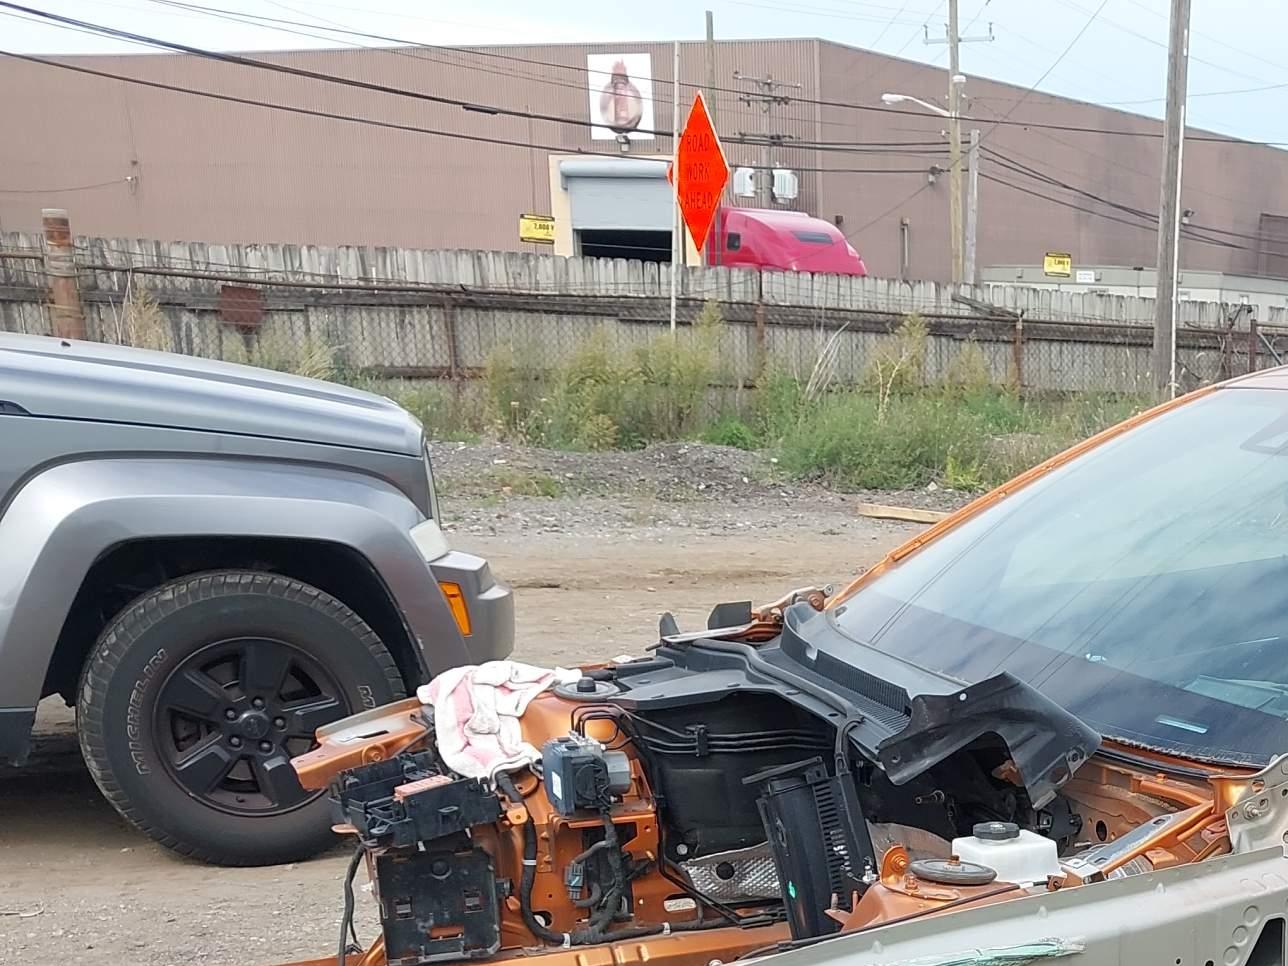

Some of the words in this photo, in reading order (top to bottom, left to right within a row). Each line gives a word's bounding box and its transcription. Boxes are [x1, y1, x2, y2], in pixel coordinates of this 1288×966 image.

[686, 133, 710, 152] ROAD
[687, 161, 710, 181] WORK
[684, 191, 713, 209] AHEAD
[127, 648, 169, 775] MICHELIN
